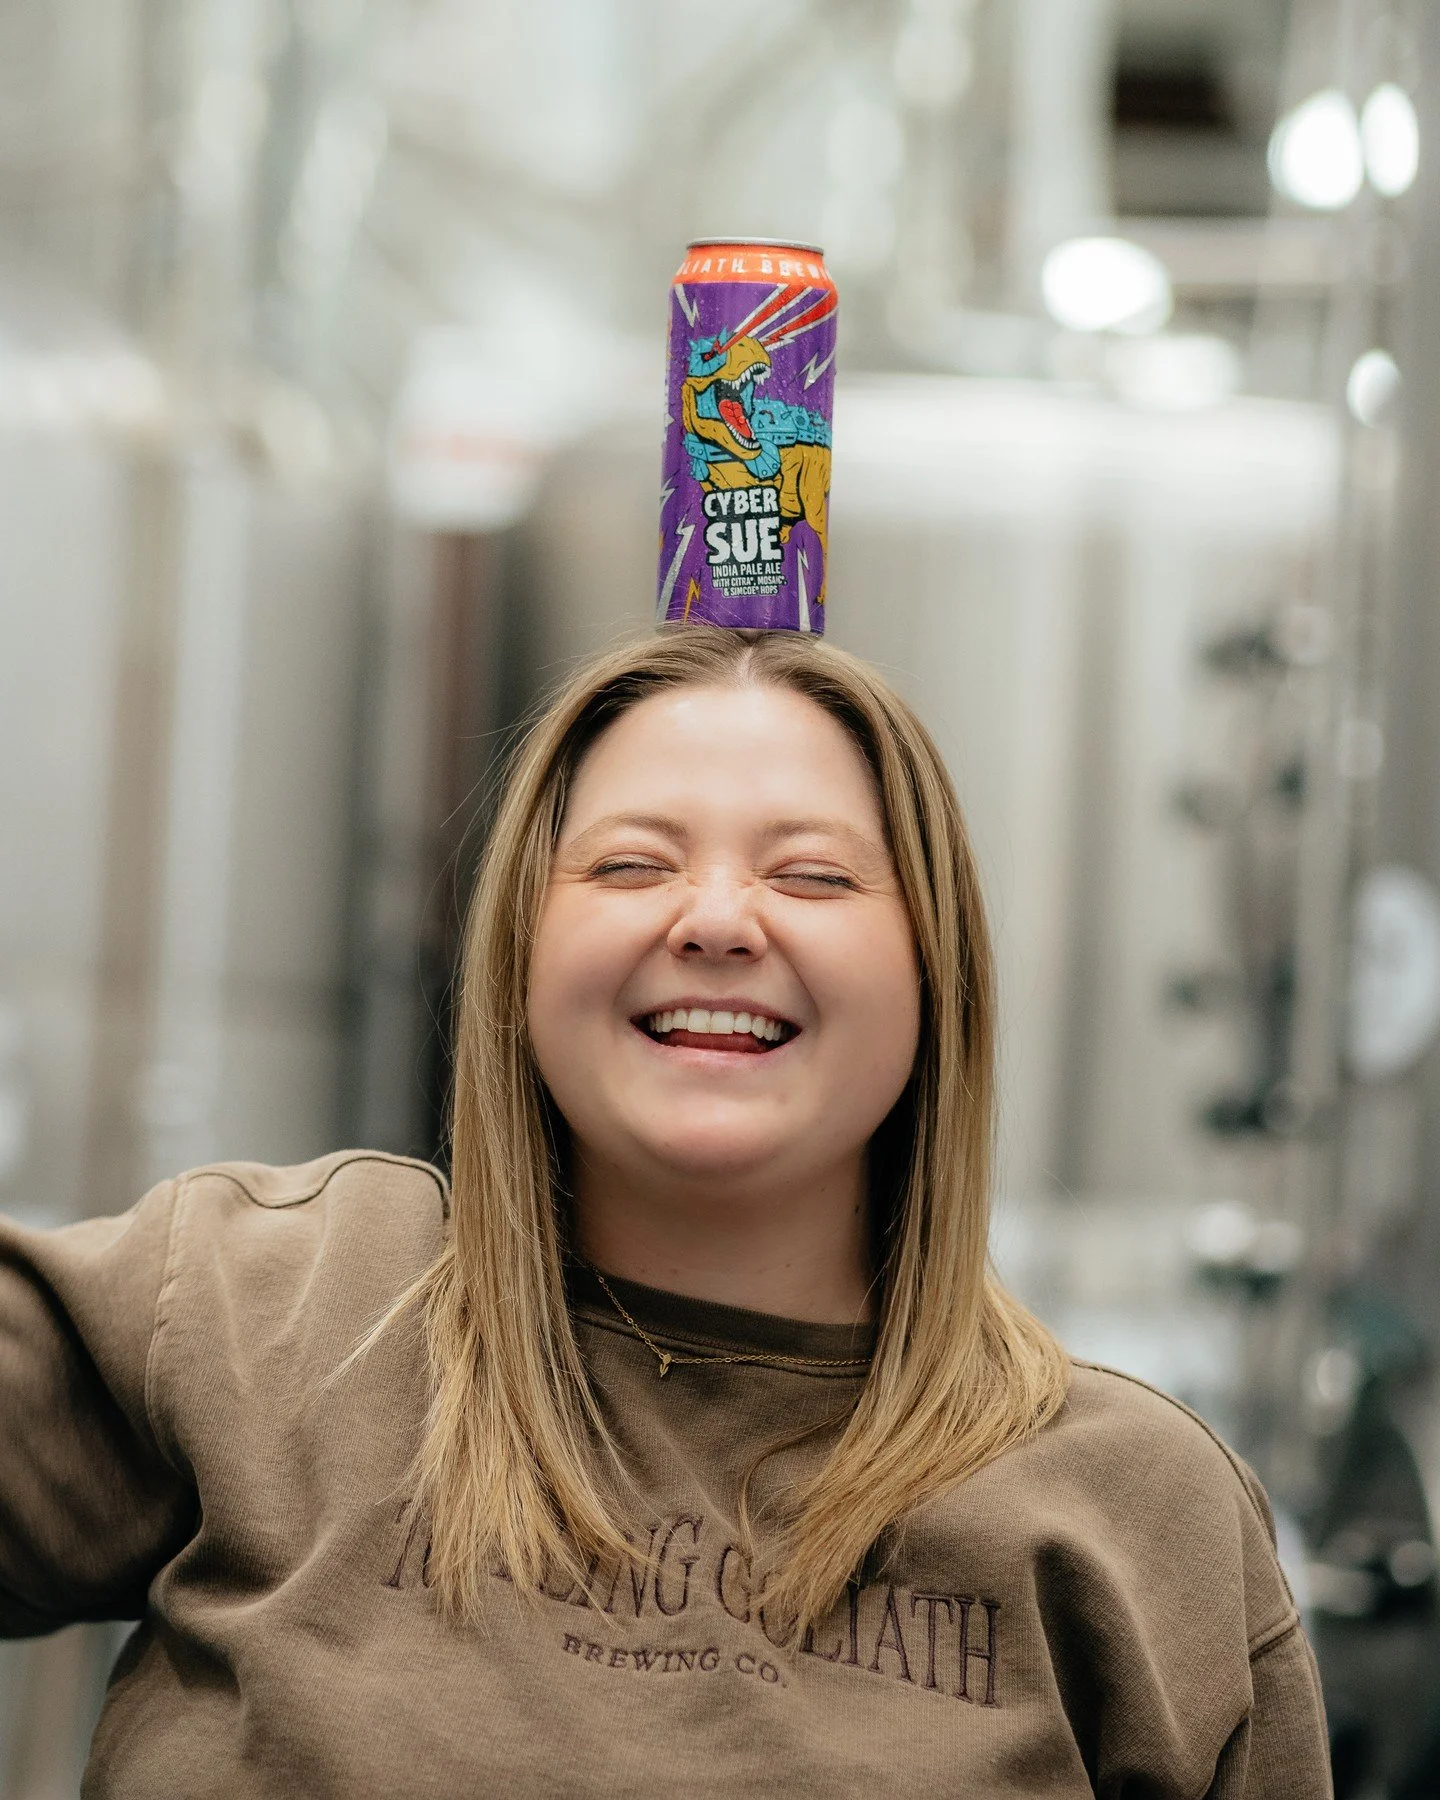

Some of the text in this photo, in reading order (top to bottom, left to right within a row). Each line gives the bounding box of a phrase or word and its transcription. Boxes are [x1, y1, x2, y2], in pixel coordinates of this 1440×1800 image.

[704, 488, 779, 517] CYBER
[706, 517, 782, 564] SUE
[713, 562, 781, 578] INDIA PALE ALE
[713, 577, 730, 588] WITH
[723, 588, 730, 597] &
[761, 585, 778, 594] HOPS
[563, 1632, 788, 1689] BREWING CO.
